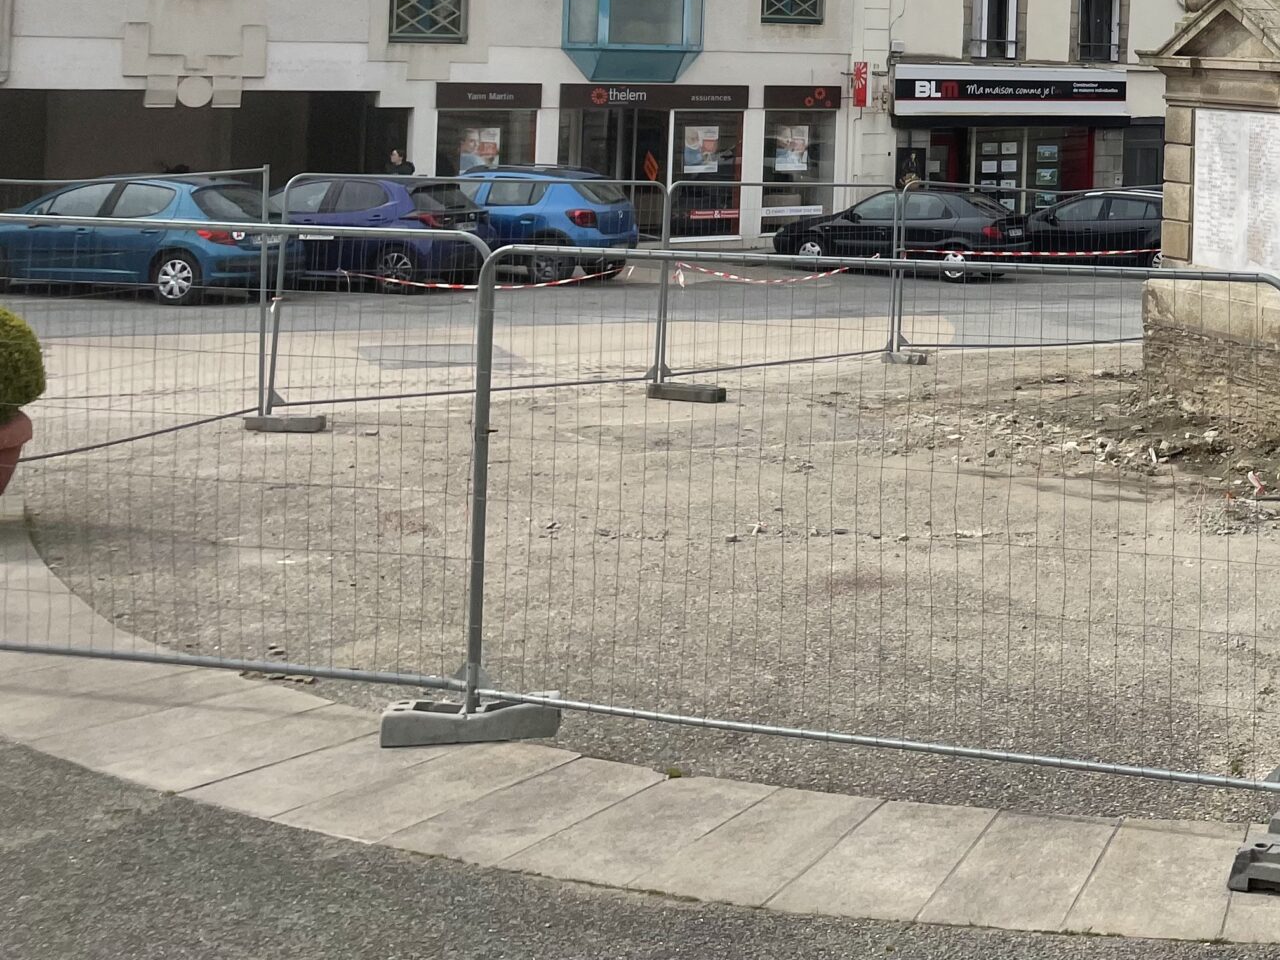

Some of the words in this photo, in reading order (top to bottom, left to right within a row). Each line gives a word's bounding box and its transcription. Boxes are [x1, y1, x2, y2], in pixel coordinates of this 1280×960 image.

[467, 92, 487, 100] Yann
[489, 92, 514, 100] Martin
[966, 83, 984, 95] Ma
[985, 85, 1014, 95] maison
[1015, 87, 1042, 95] comme
[1040, 87, 1050, 99] je
